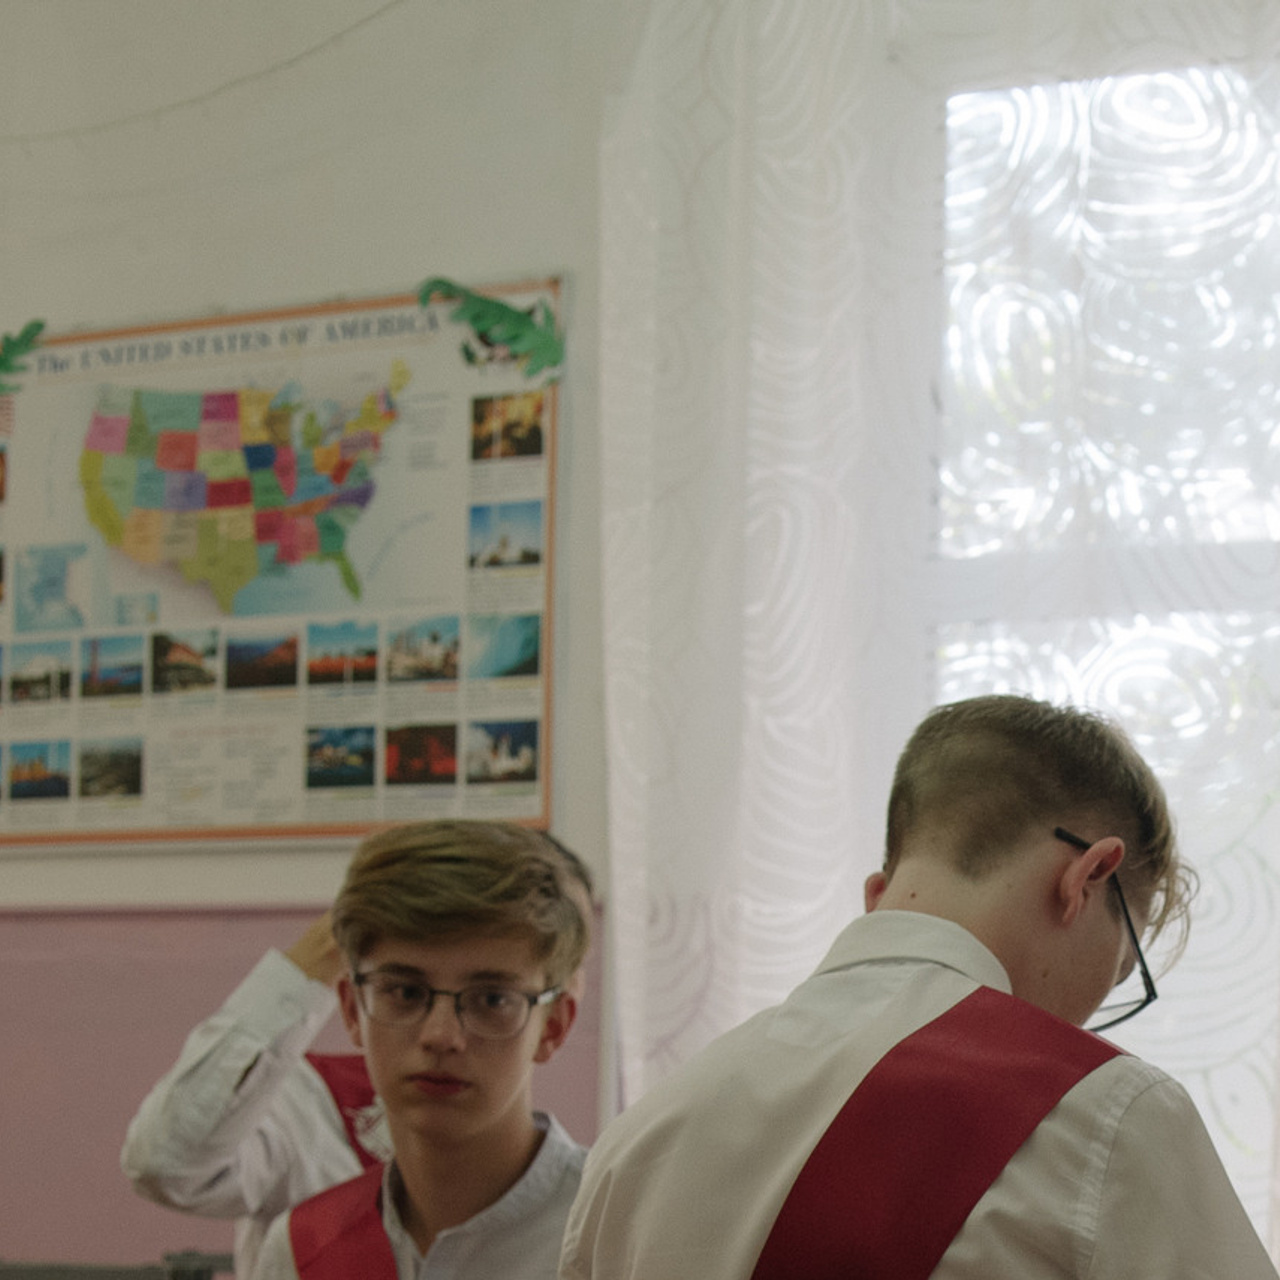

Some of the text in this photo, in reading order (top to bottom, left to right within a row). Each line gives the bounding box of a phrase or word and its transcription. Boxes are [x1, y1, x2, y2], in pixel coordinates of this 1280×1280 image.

[80, 340, 173, 370] UNITED
[180, 330, 272, 356] STATES
[278, 323, 309, 346] OF
[325, 311, 439, 343] AMERICA
